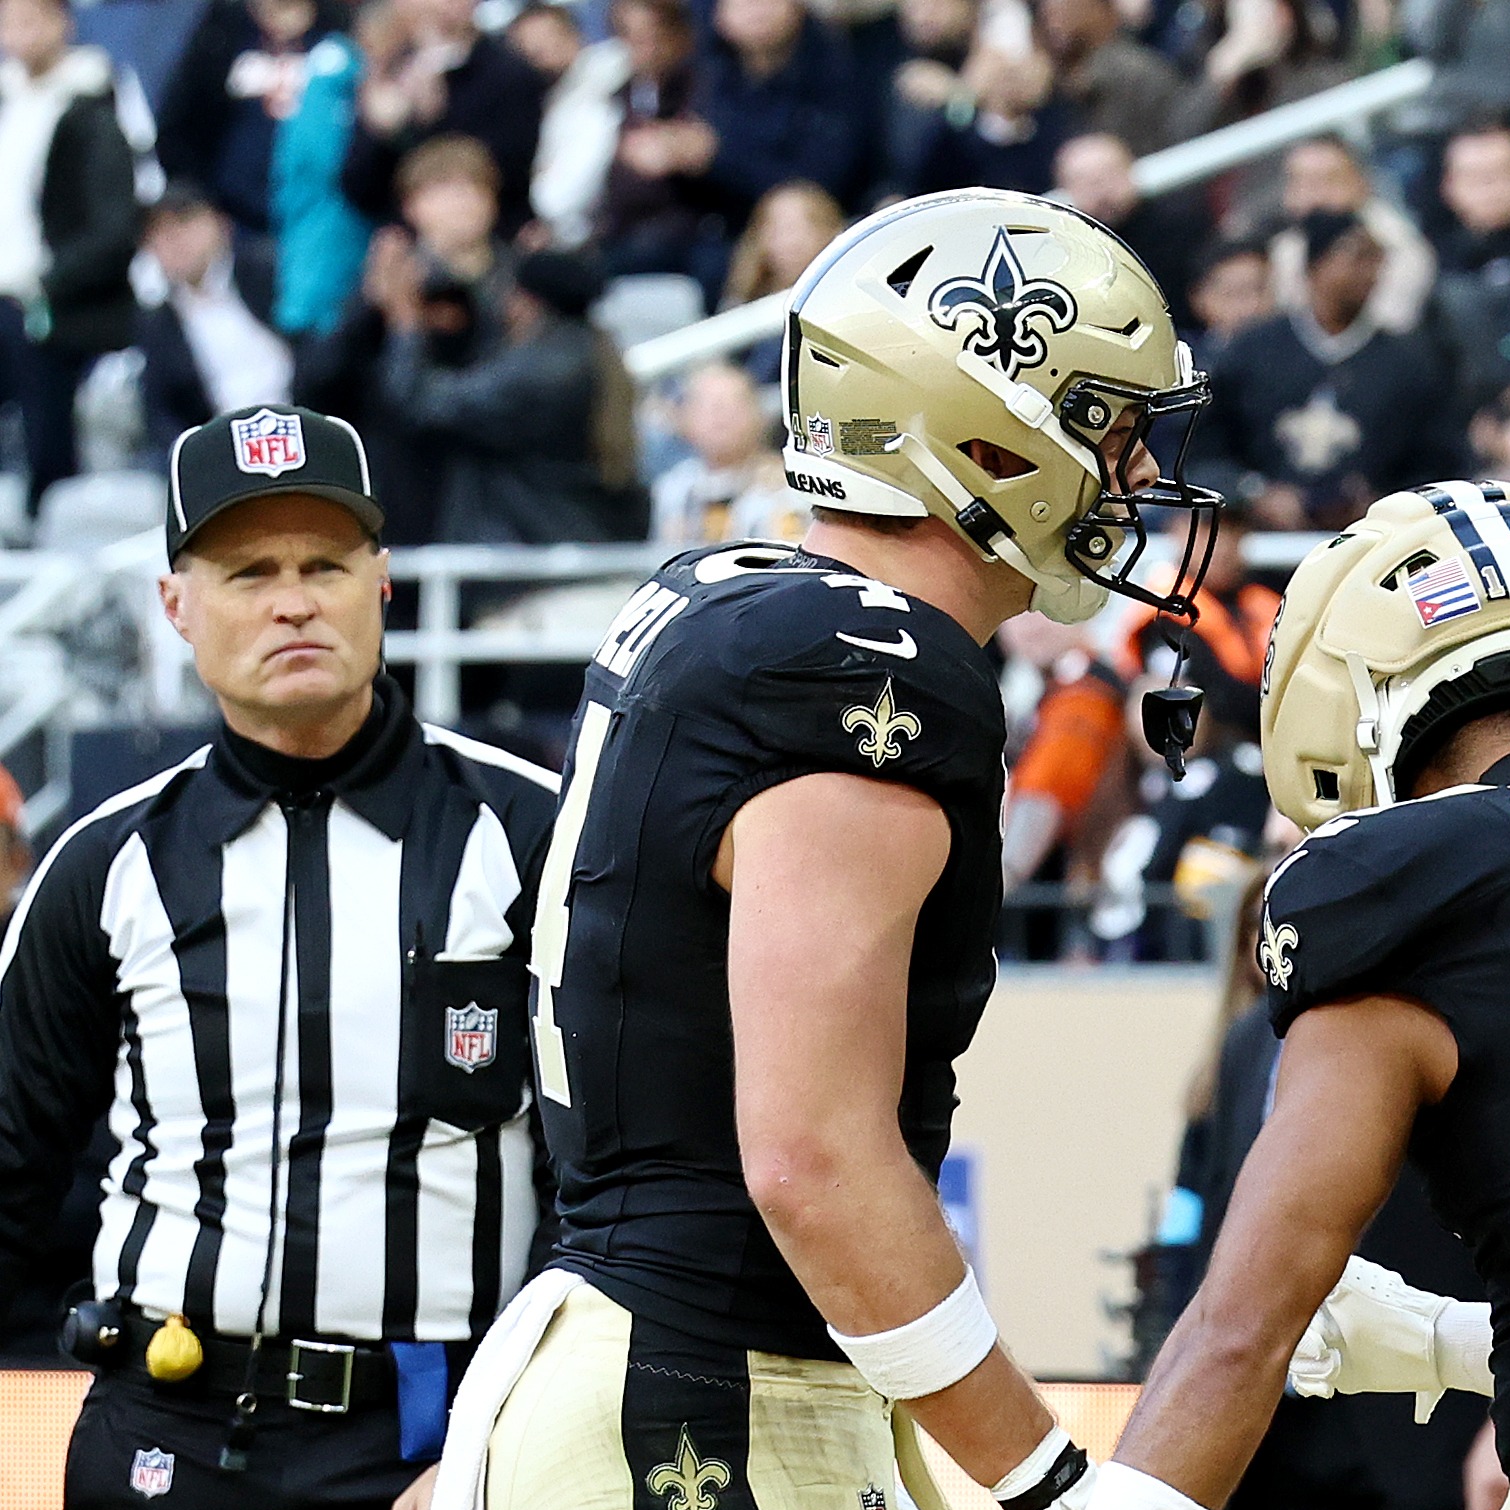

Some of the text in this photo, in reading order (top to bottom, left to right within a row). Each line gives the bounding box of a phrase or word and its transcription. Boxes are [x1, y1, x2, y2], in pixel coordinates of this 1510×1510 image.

[245, 436, 298, 465] NFL
[1481, 565, 1506, 599] 1
[454, 1033, 490, 1061] NFL
